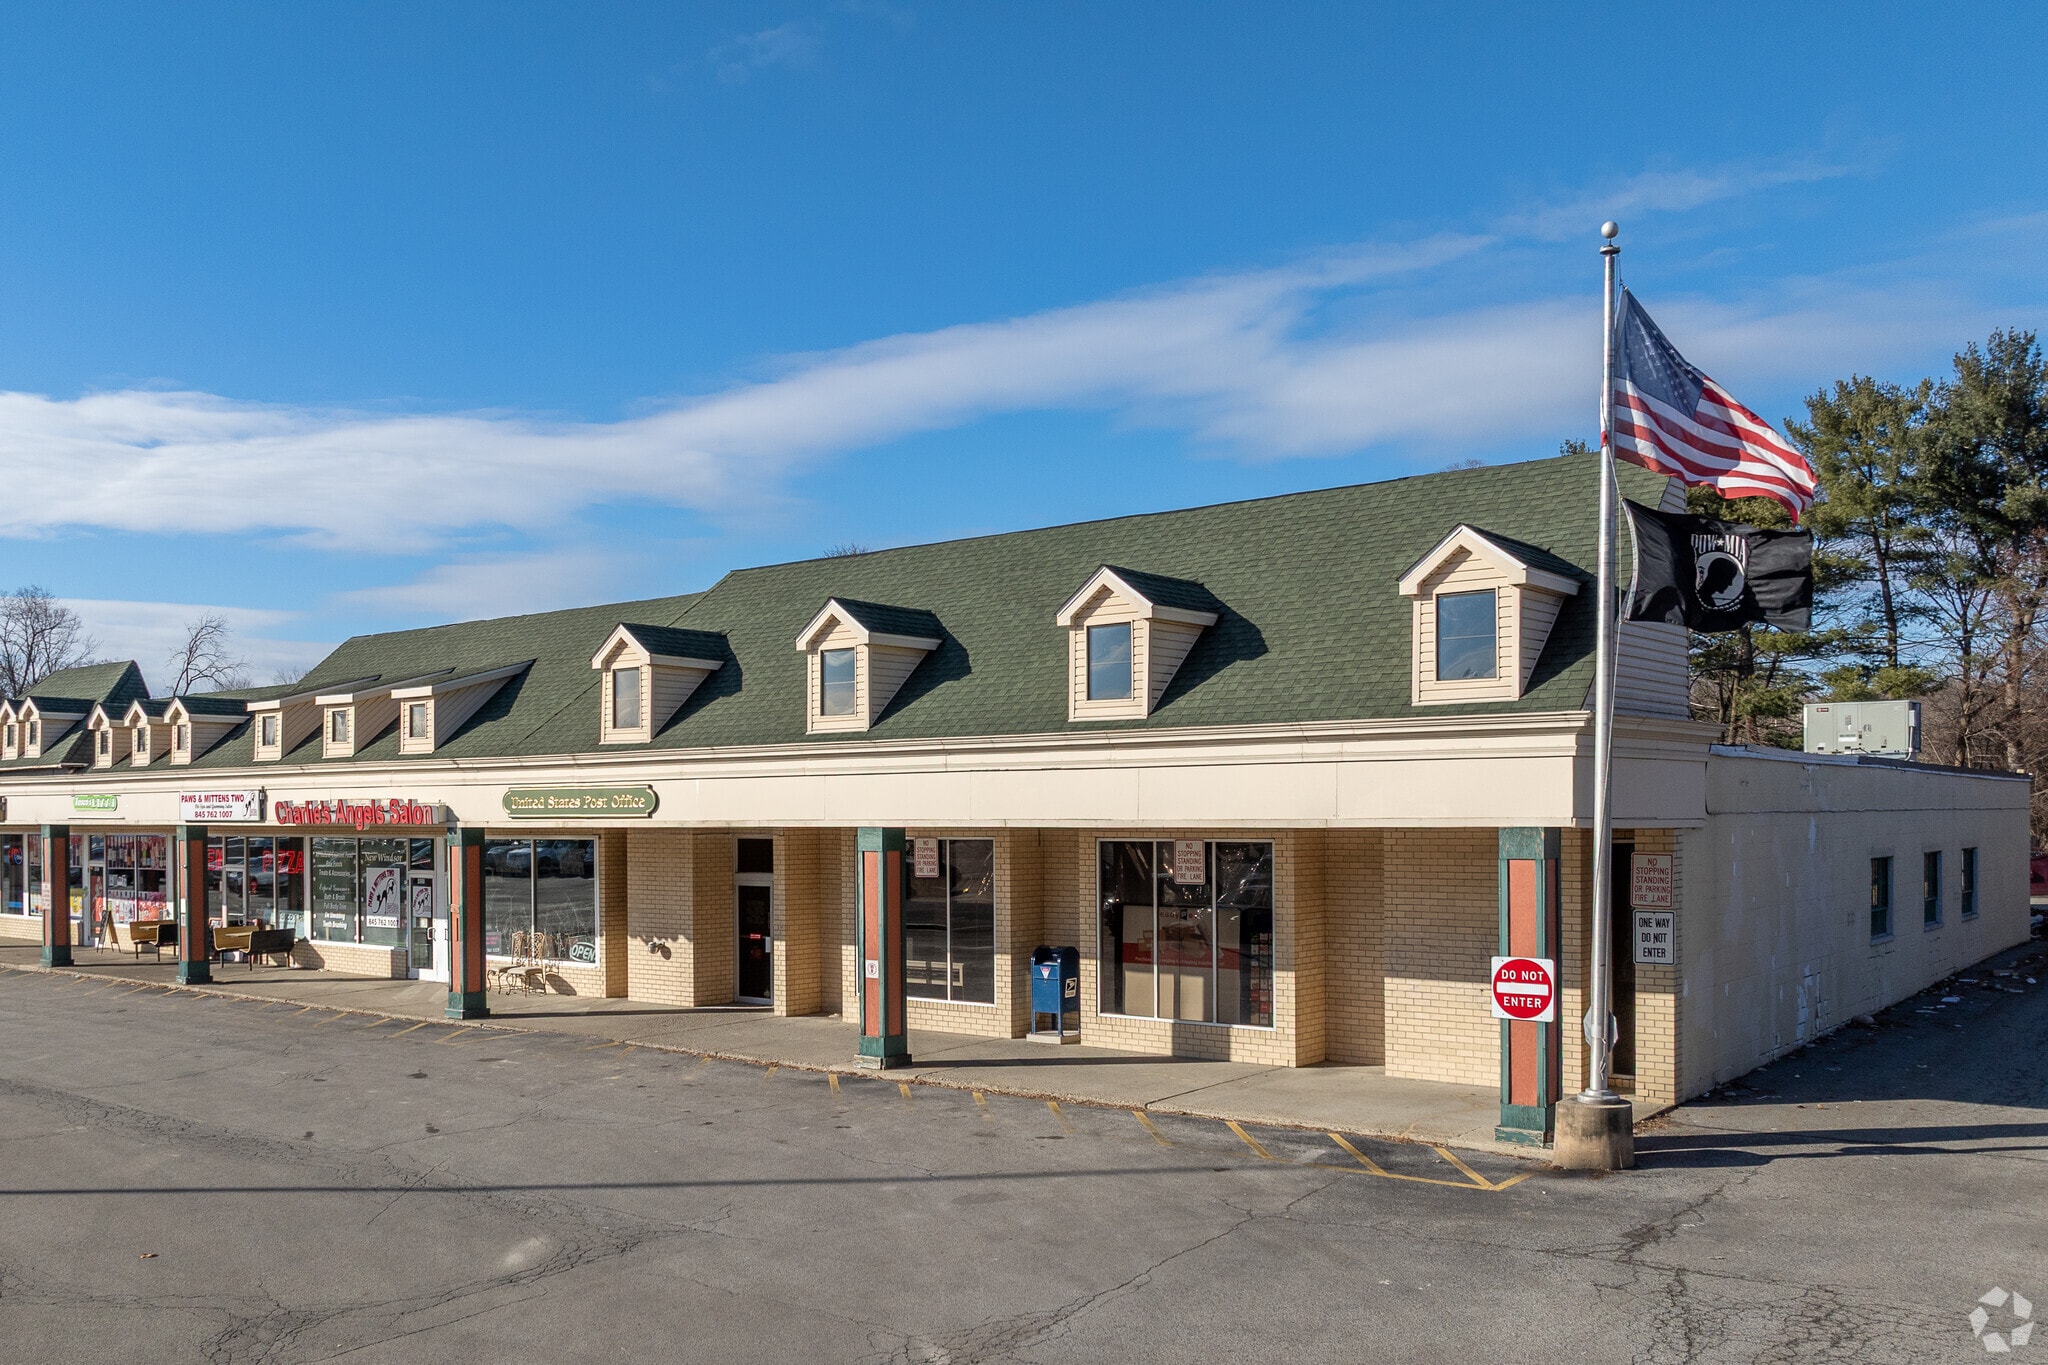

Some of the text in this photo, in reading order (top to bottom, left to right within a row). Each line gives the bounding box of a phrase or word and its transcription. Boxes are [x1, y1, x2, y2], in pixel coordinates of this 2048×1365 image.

[1691, 533, 1746, 570] POW MIA
[181, 794, 245, 803] PAWS & MITTENS TWO
[510, 794, 646, 809] United States Post Office
[275, 800, 332, 825] Charlie's
[335, 799, 385, 831] Angels
[389, 798, 433, 825] Salon
[262, 850, 304, 874] PZZA
[364, 853, 377, 862] New
[378, 852, 402, 862] Windsor
[1177, 857, 1202, 865] STANDING
[1647, 858, 1657, 867] NO
[1635, 867, 1670, 876] STOPPING
[1635, 876, 1670, 885] STANDING
[1634, 885, 1671, 894] OR PARKING
[1635, 894, 1670, 903] FIRE LANE
[1638, 917, 1670, 928] ONE WAY
[1641, 932, 1667, 944] DO NOT
[571, 944, 595, 961] OPEN
[1643, 947, 1666, 958] ENTER
[1501, 969, 1544, 982] DO NOT
[1503, 996, 1542, 1009] ENTER
